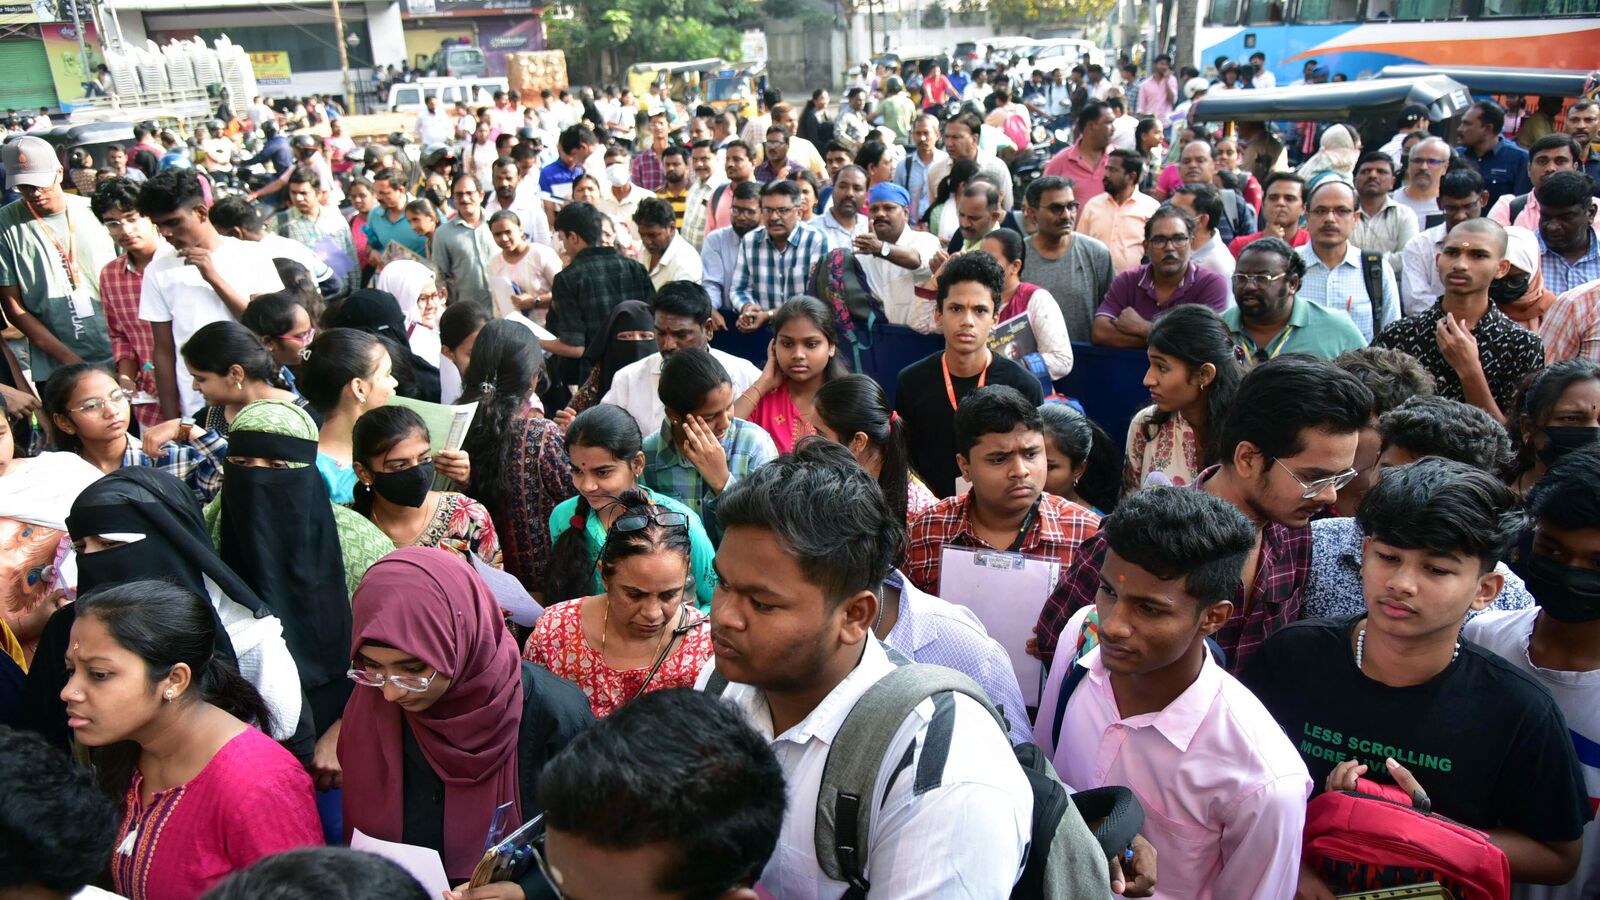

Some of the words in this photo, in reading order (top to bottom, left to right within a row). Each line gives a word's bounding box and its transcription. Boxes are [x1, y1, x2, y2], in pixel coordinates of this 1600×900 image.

[1301, 740, 1346, 762] MORE
[1304, 723, 1342, 744] LESS
[1348, 737, 1452, 771] SCROLLING
